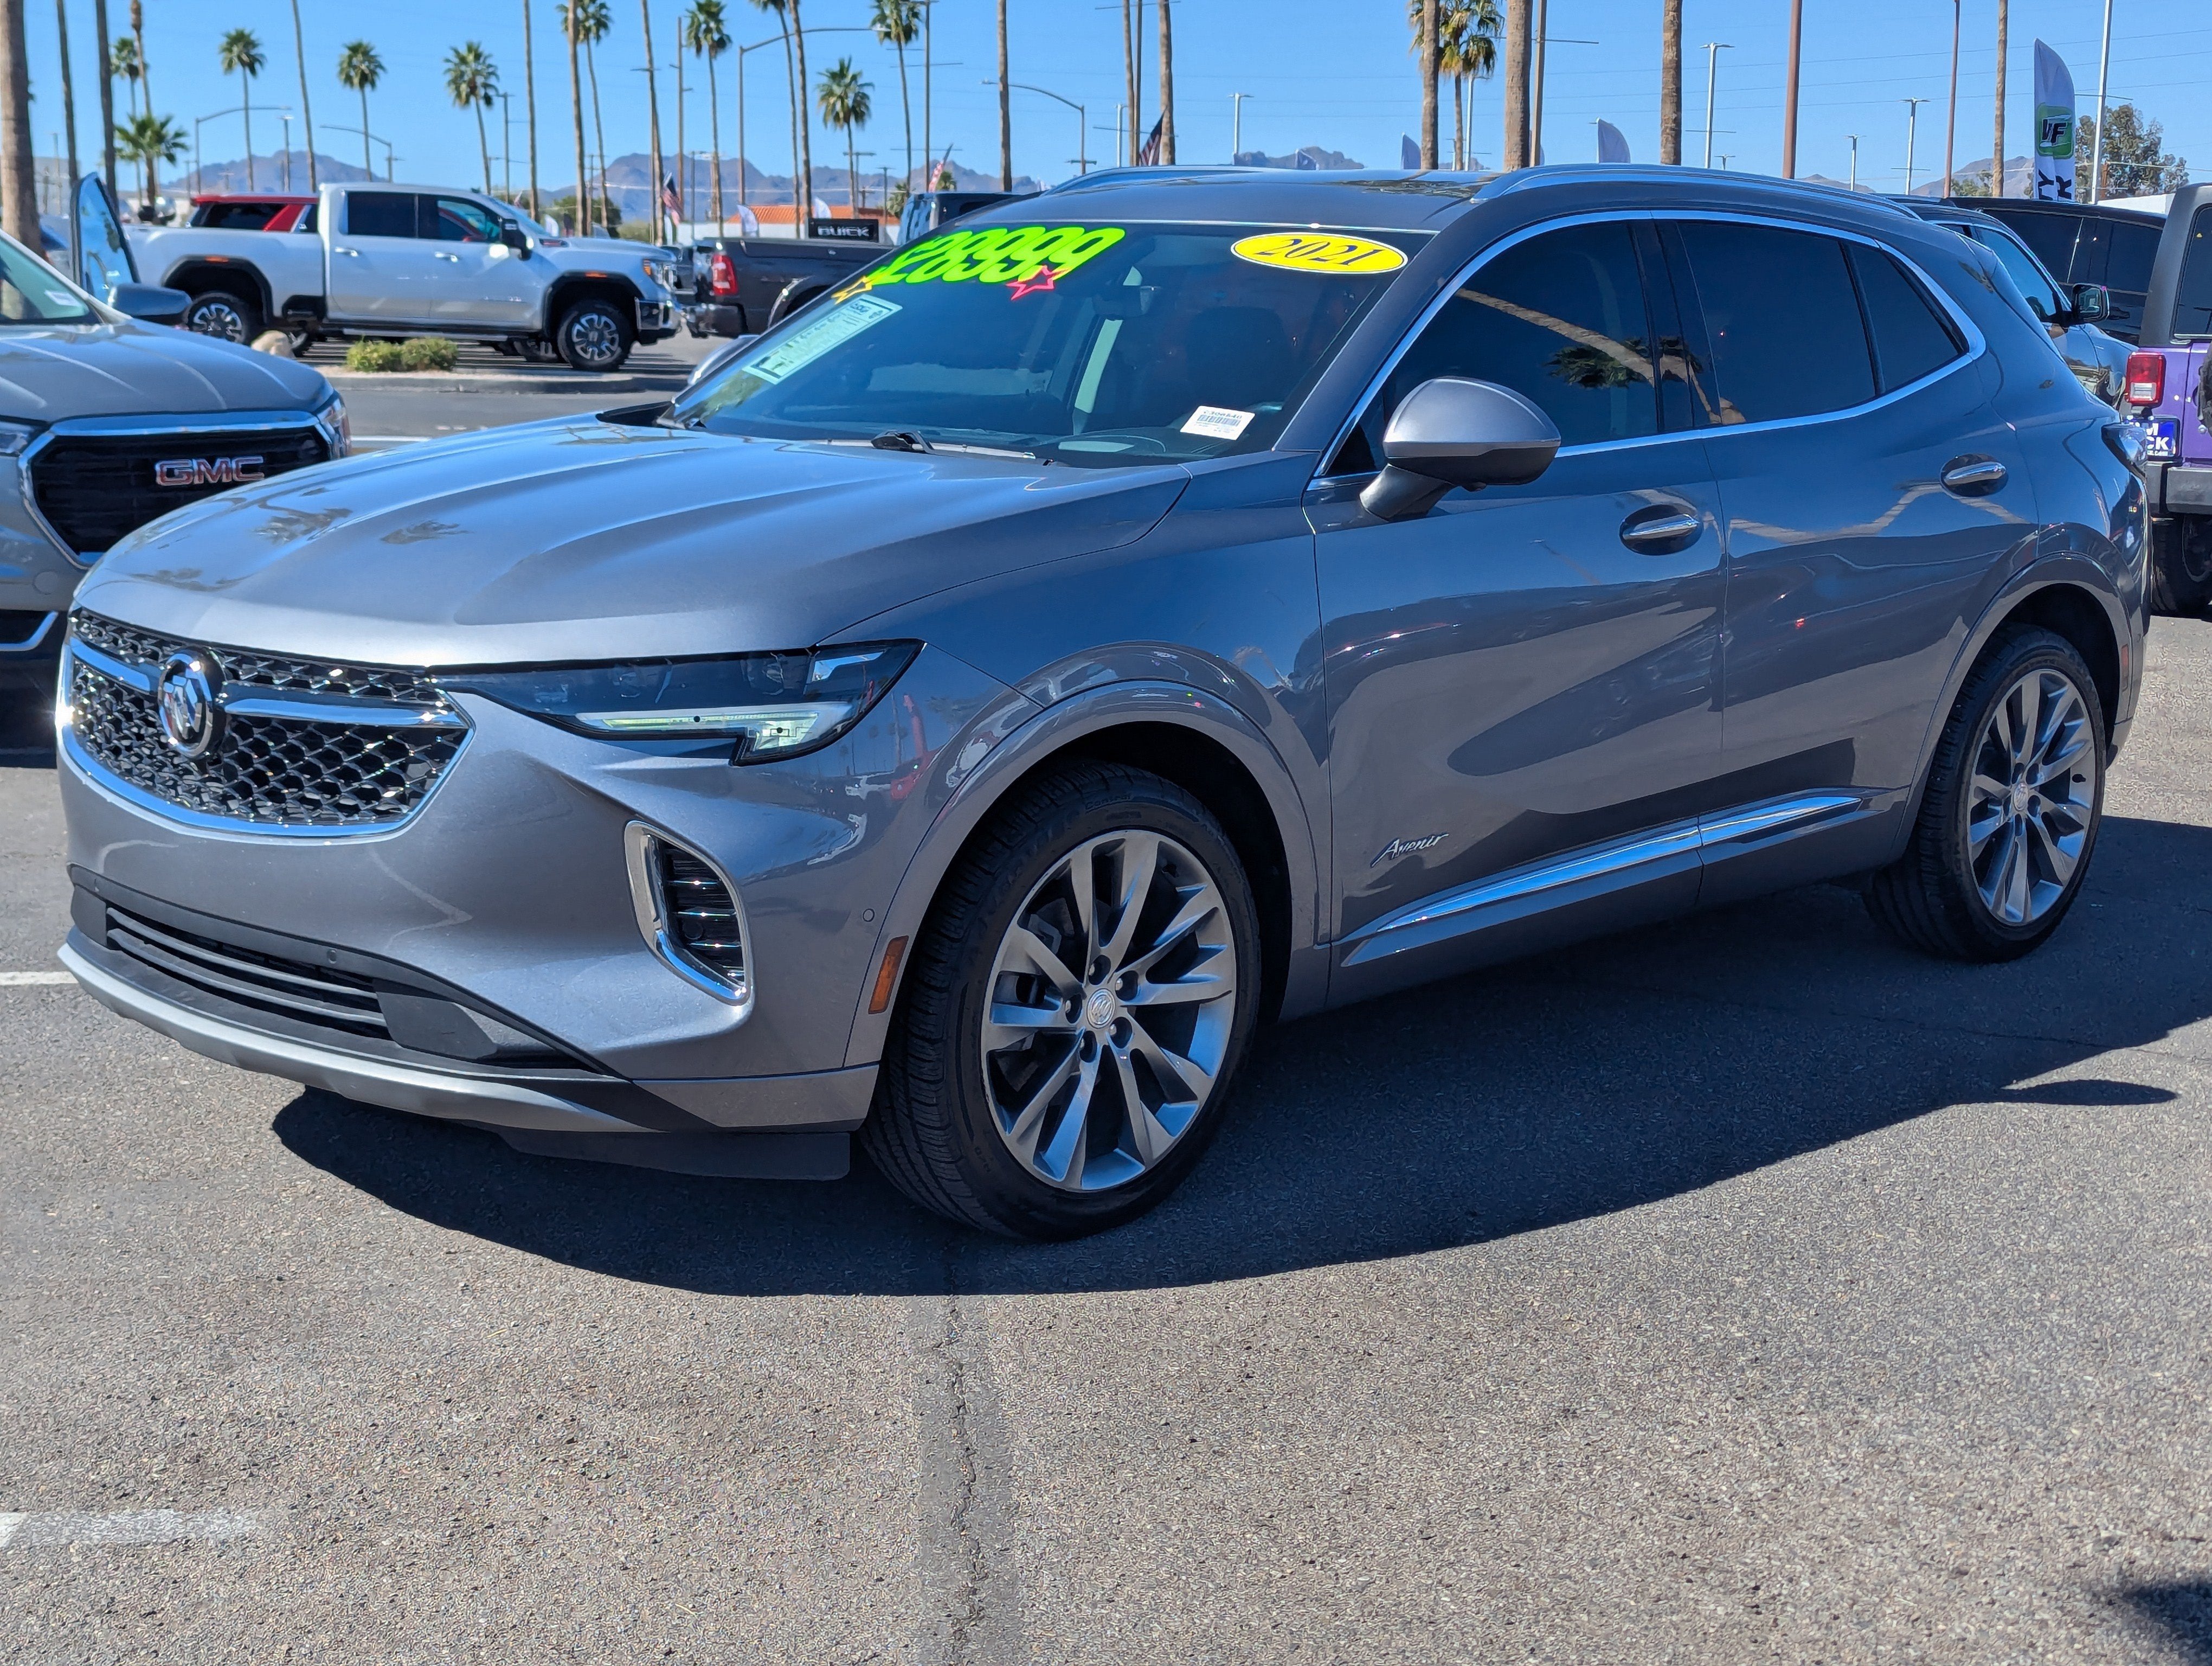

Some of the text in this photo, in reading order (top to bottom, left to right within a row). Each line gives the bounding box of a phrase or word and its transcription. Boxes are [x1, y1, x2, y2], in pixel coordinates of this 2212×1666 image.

[817, 226, 870, 237] BUICK
[1253, 238, 1385, 266] 2021
[155, 455, 265, 486] GMC
[1371, 833, 1449, 868] Avenir
